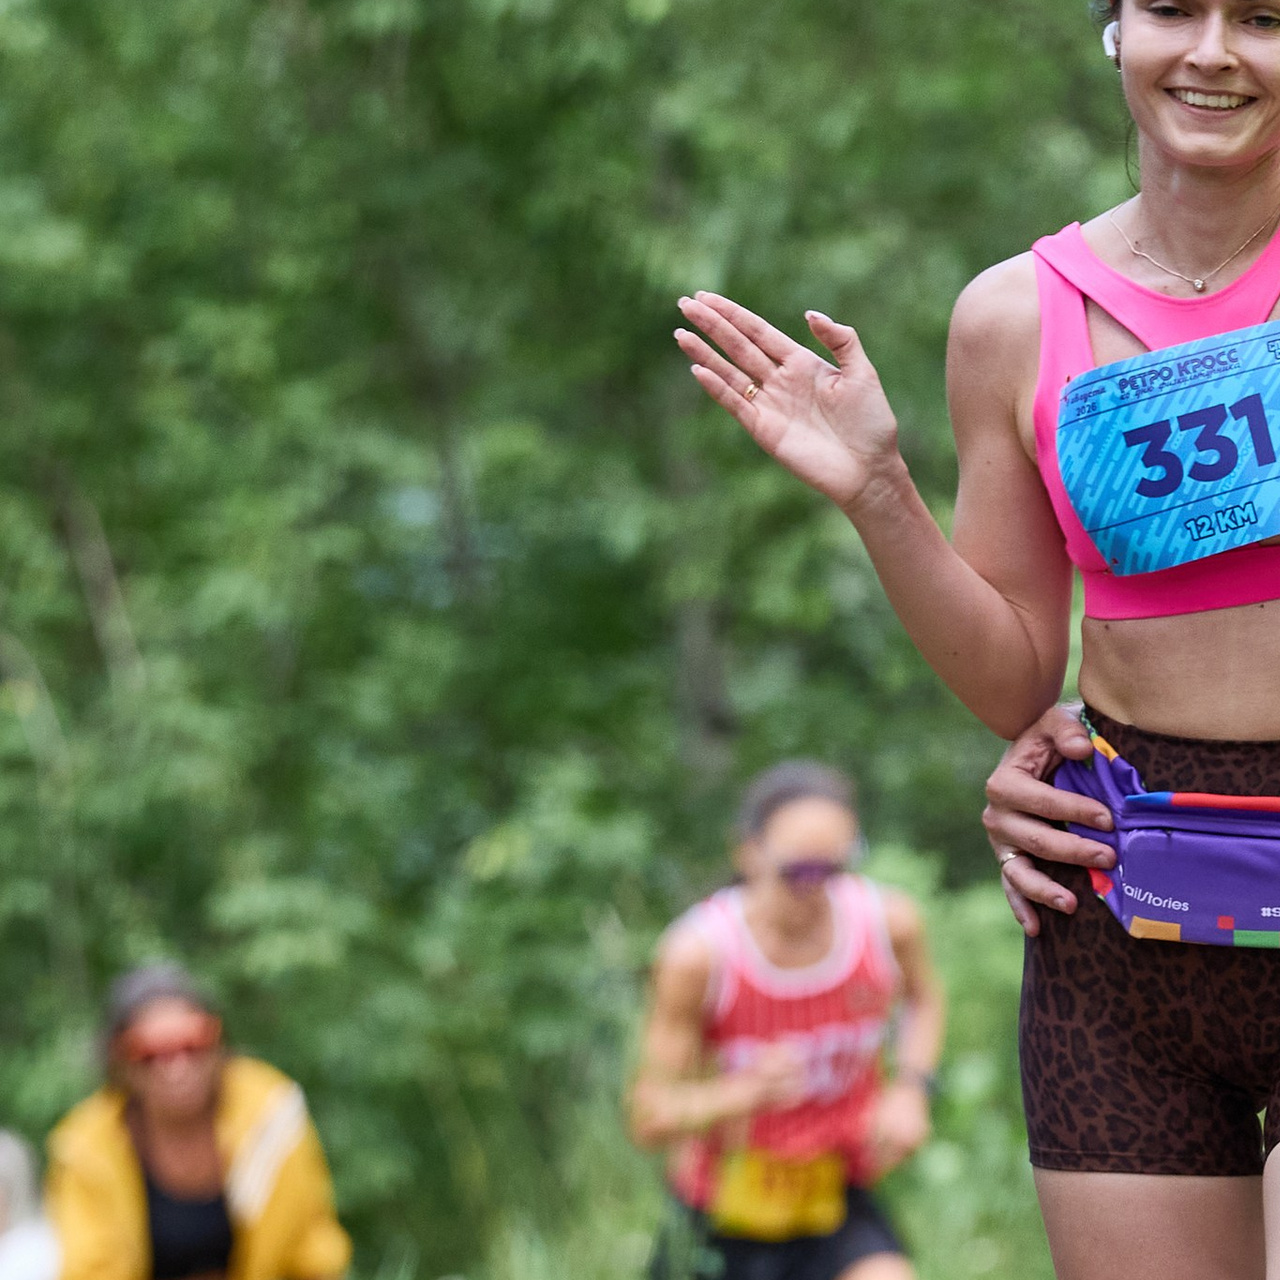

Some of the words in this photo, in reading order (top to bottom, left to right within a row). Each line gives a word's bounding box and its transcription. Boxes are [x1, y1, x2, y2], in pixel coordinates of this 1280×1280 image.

[1118, 367, 1174, 394] РЕТРО
[1177, 348, 1238, 377] КРОСС
[1076, 402, 1098, 417] 2026
[1123, 393, 1277, 498] 331
[1184, 515, 1216, 542] 12
